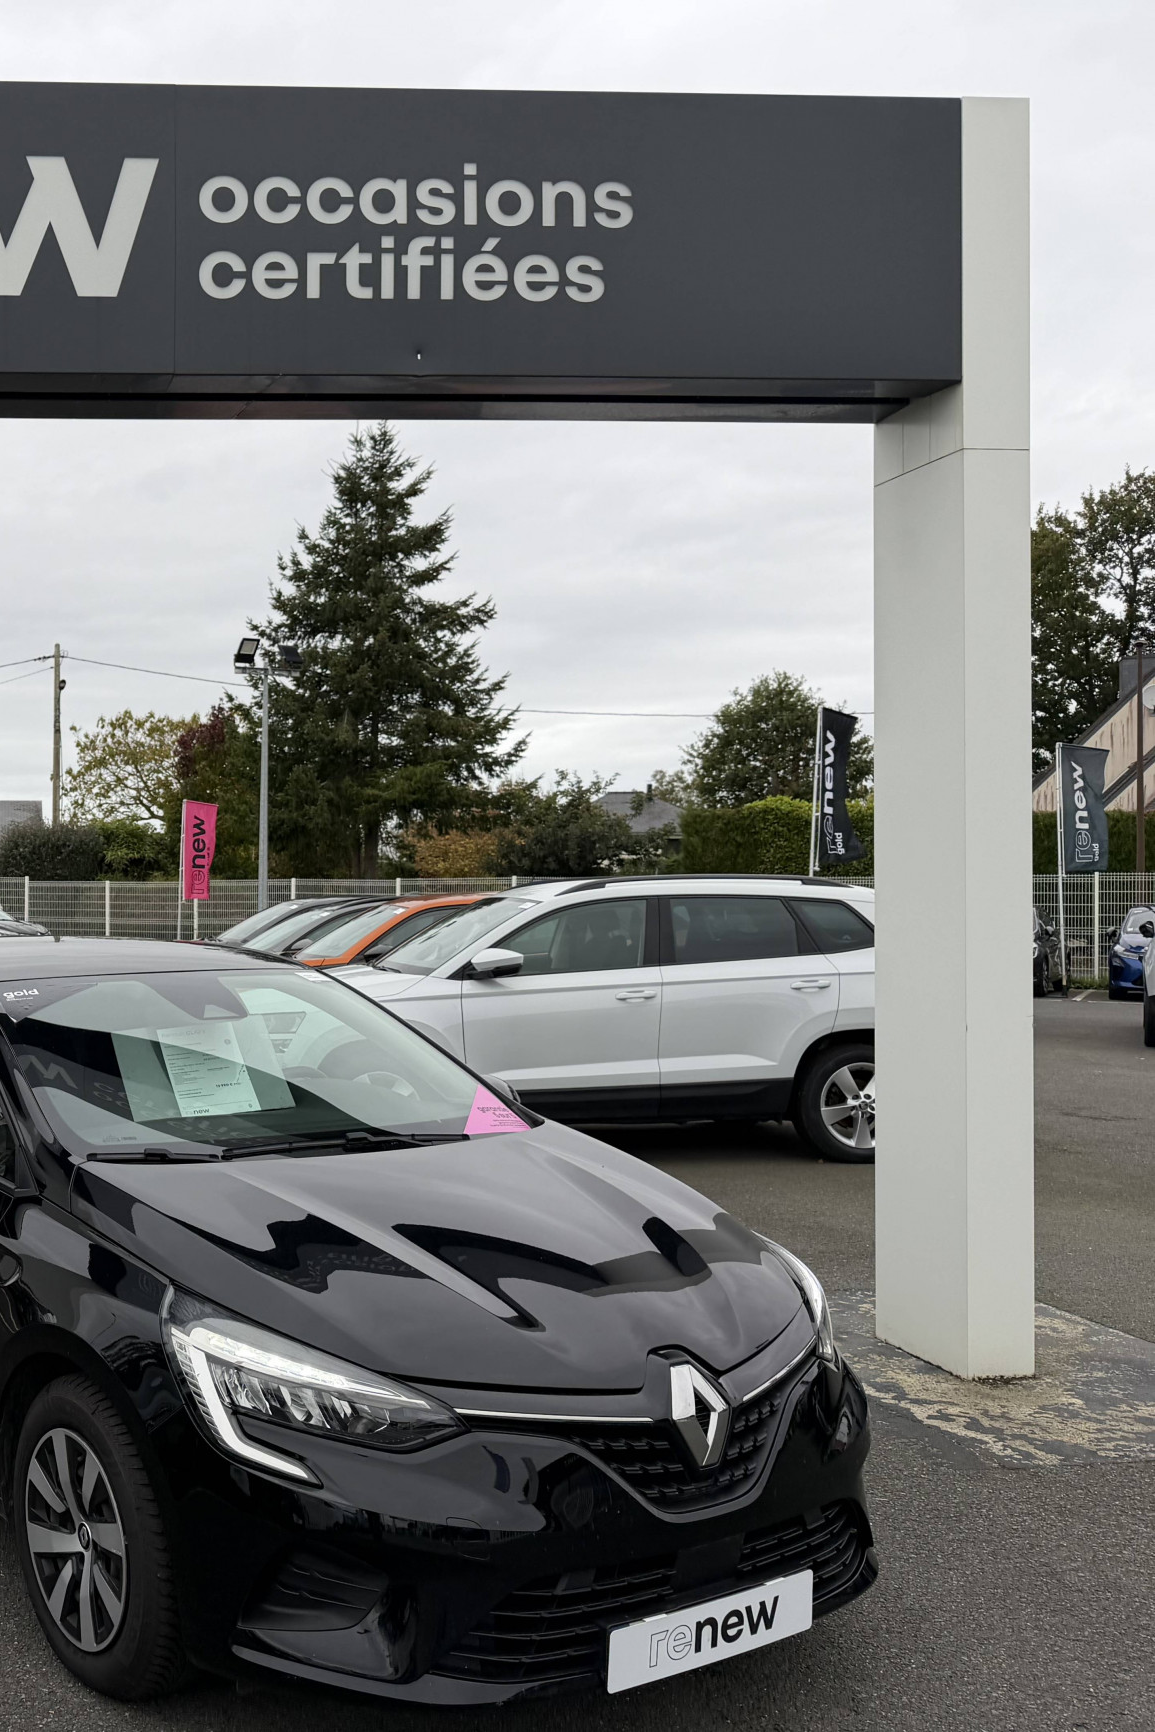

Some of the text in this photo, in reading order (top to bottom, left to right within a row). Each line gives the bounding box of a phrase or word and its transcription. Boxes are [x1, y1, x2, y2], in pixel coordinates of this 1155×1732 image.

[198, 162, 634, 229] occasions
[198, 236, 605, 303] certifiées
[823, 729, 839, 855] renew
[1071, 760, 1093, 863] renew
[191, 815, 207, 895] renew
[834, 832, 845, 856] gold
[3, 988, 40, 999] gold
[648, 1594, 780, 1669] renew
